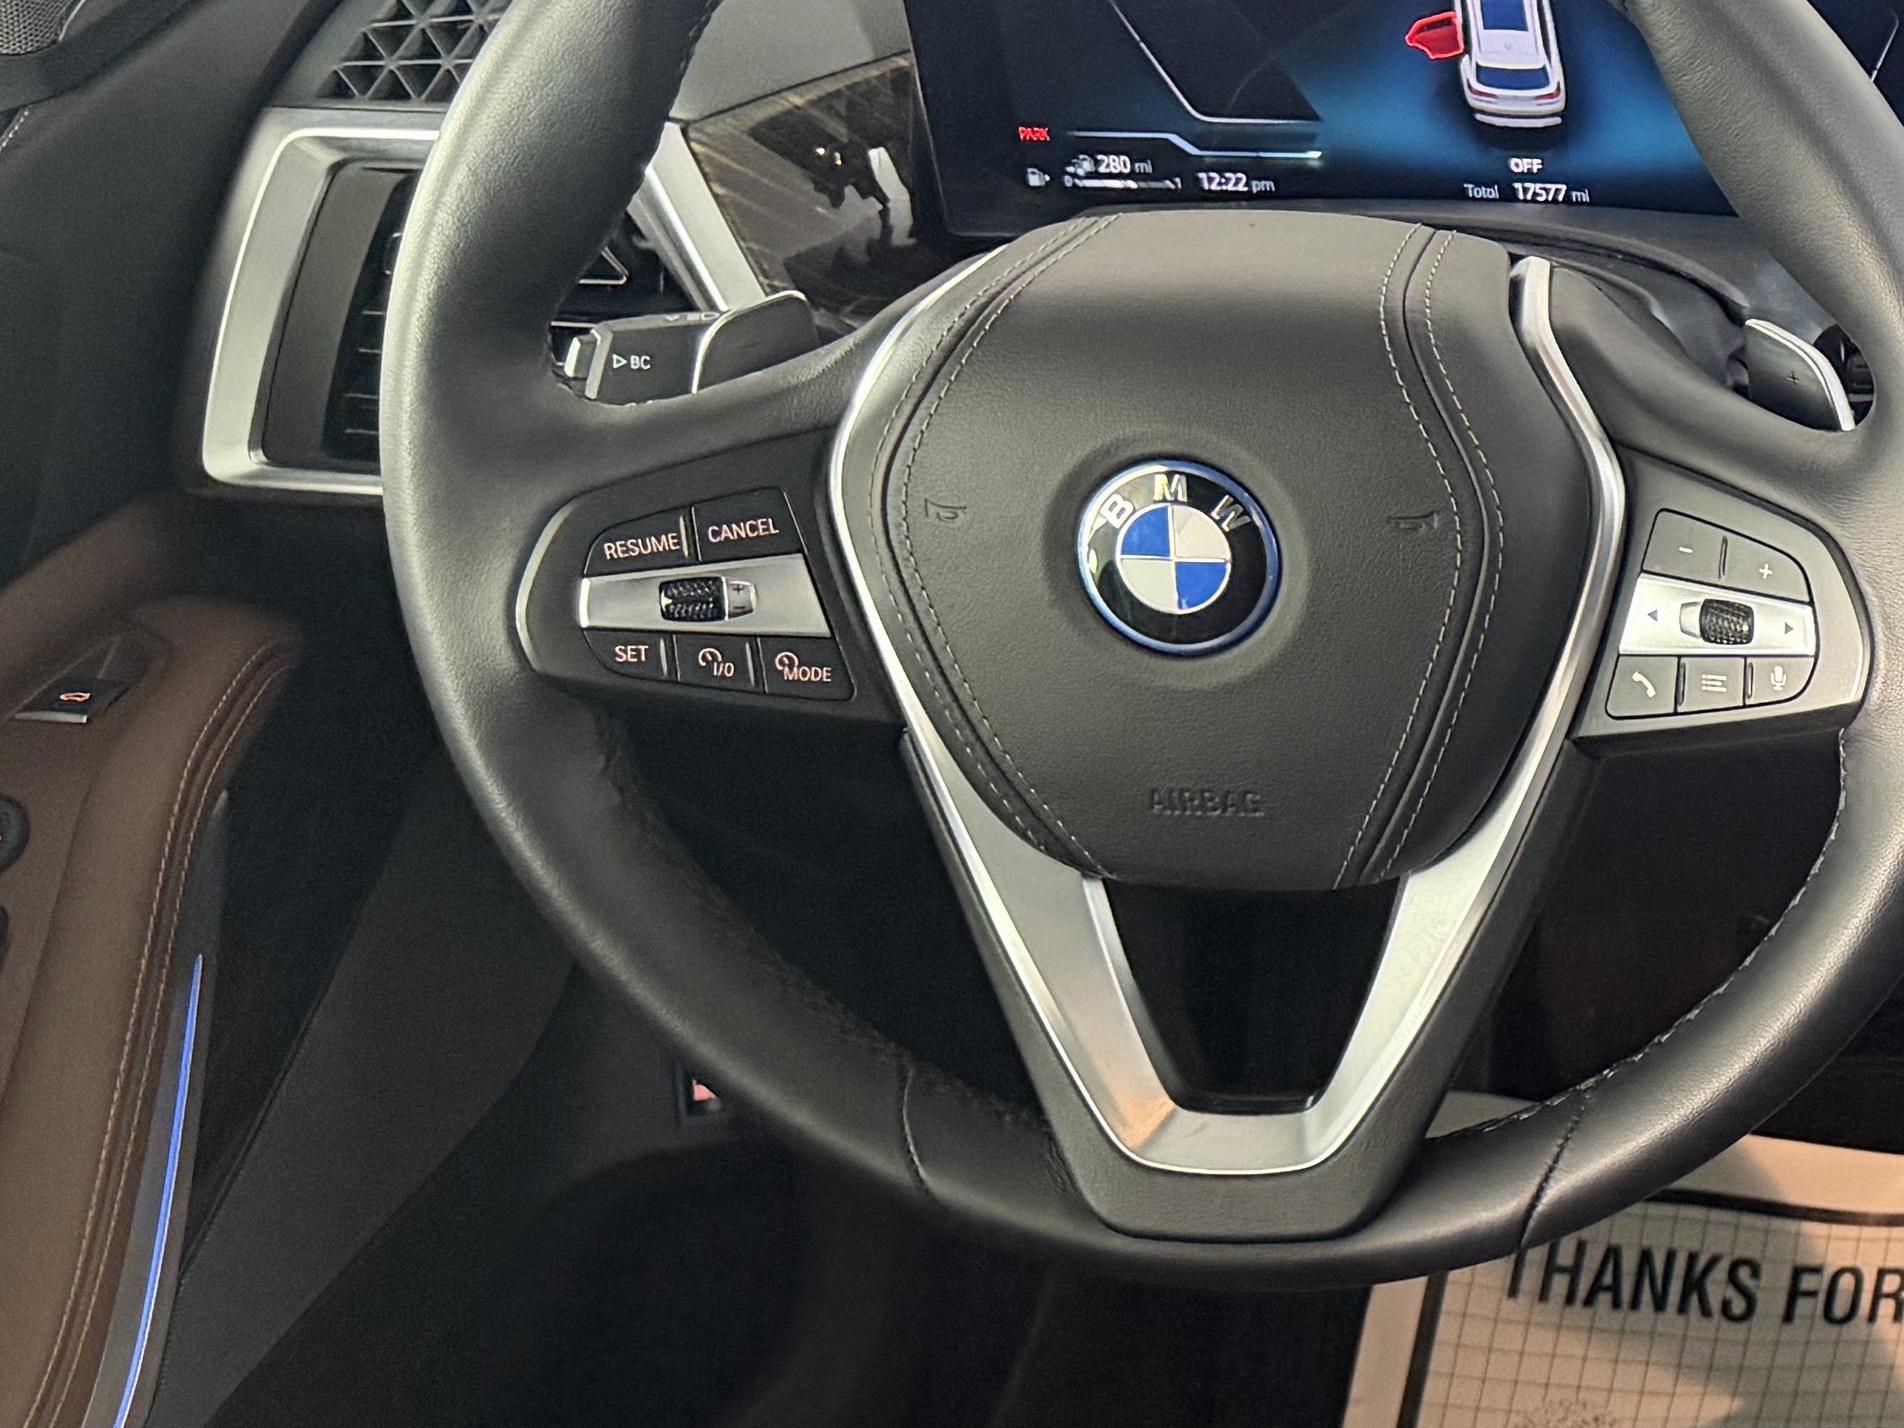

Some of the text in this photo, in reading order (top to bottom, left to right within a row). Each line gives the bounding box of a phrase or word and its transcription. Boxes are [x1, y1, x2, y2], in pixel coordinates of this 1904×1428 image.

[1018, 127, 1050, 141] PARK
[1097, 155, 1152, 173] 280 mi
[1510, 158, 1543, 172] OFF
[1197, 172, 1275, 193] 12:22 pm
[1463, 183, 1590, 203] Total 17577 mi
[630, 356, 650, 370] BC
[604, 518, 779, 559] RESUME CANCEL
[615, 646, 648, 661] SET
[784, 666, 832, 682] MODE
